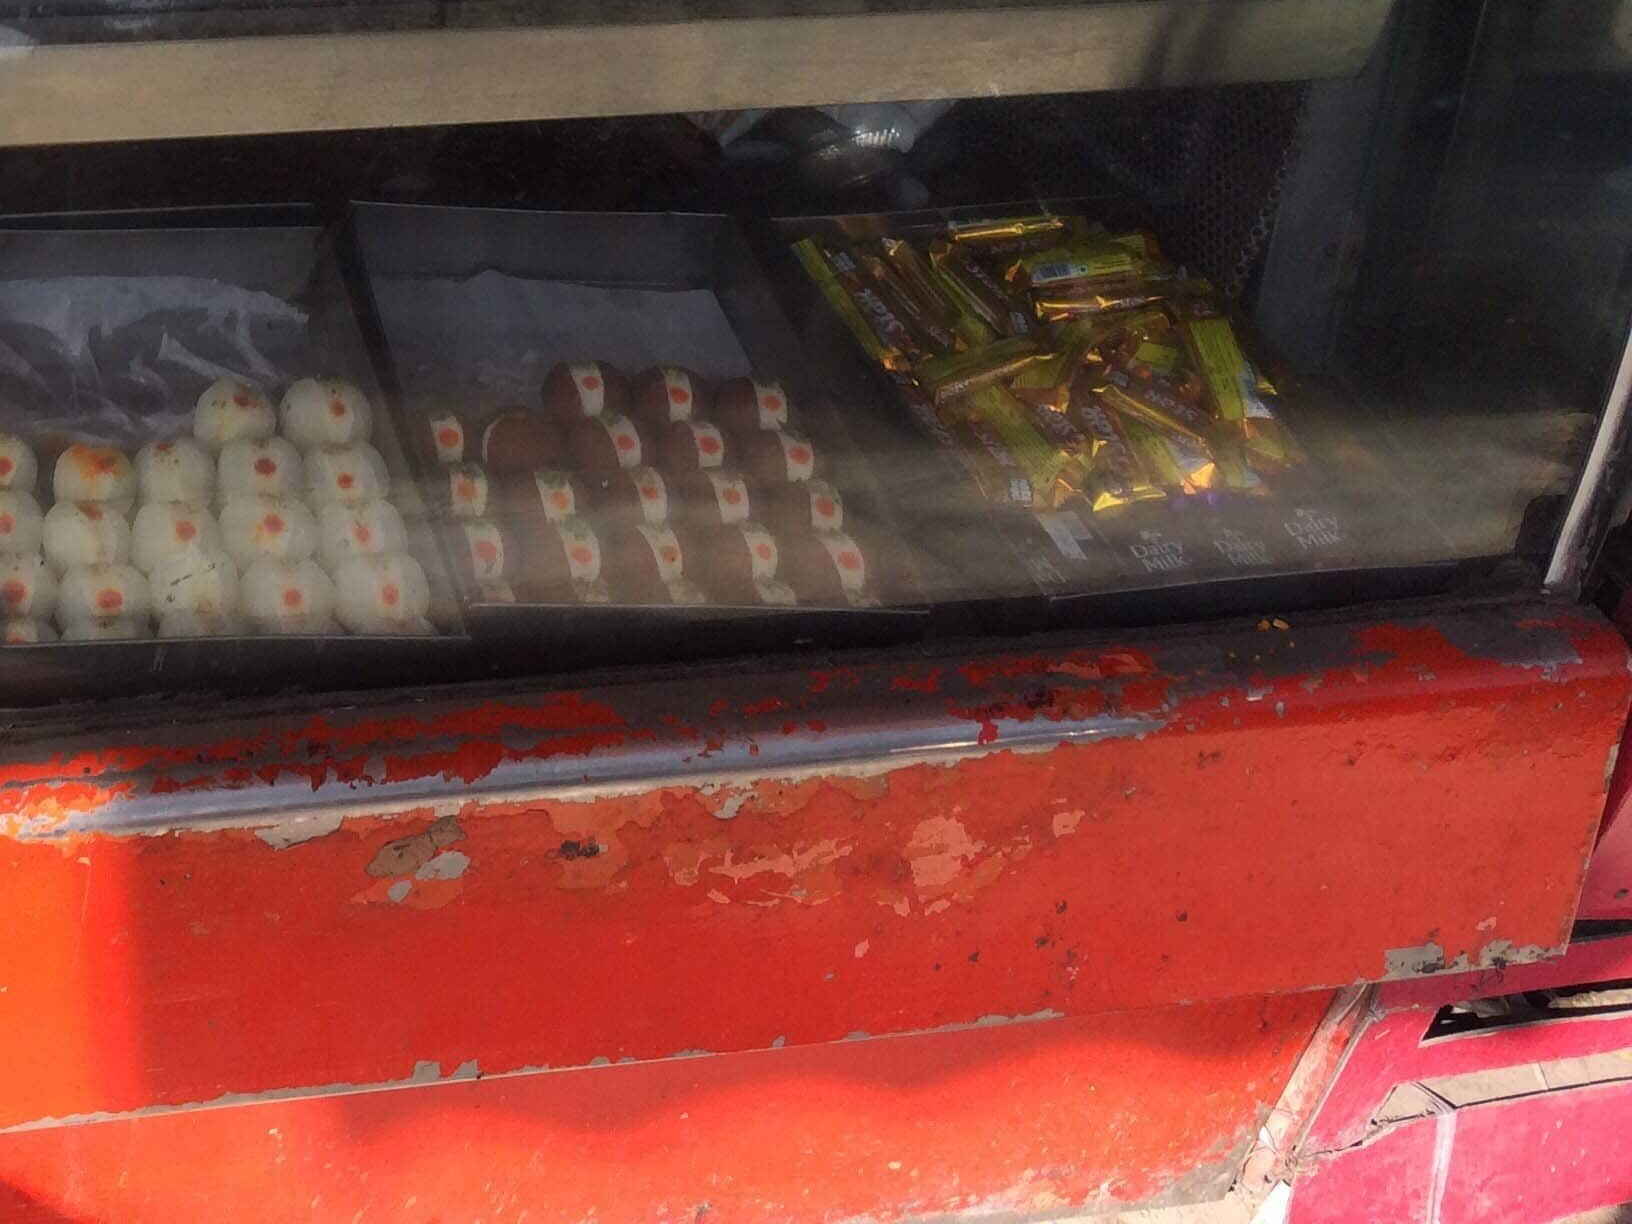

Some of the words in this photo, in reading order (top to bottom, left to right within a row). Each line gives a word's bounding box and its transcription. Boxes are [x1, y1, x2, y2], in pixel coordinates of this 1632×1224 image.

[1282, 517, 1340, 539] Dairy
[1130, 541, 1184, 558] Dairy
[1297, 532, 1342, 550] Milk
[1142, 554, 1186, 573] Milk
